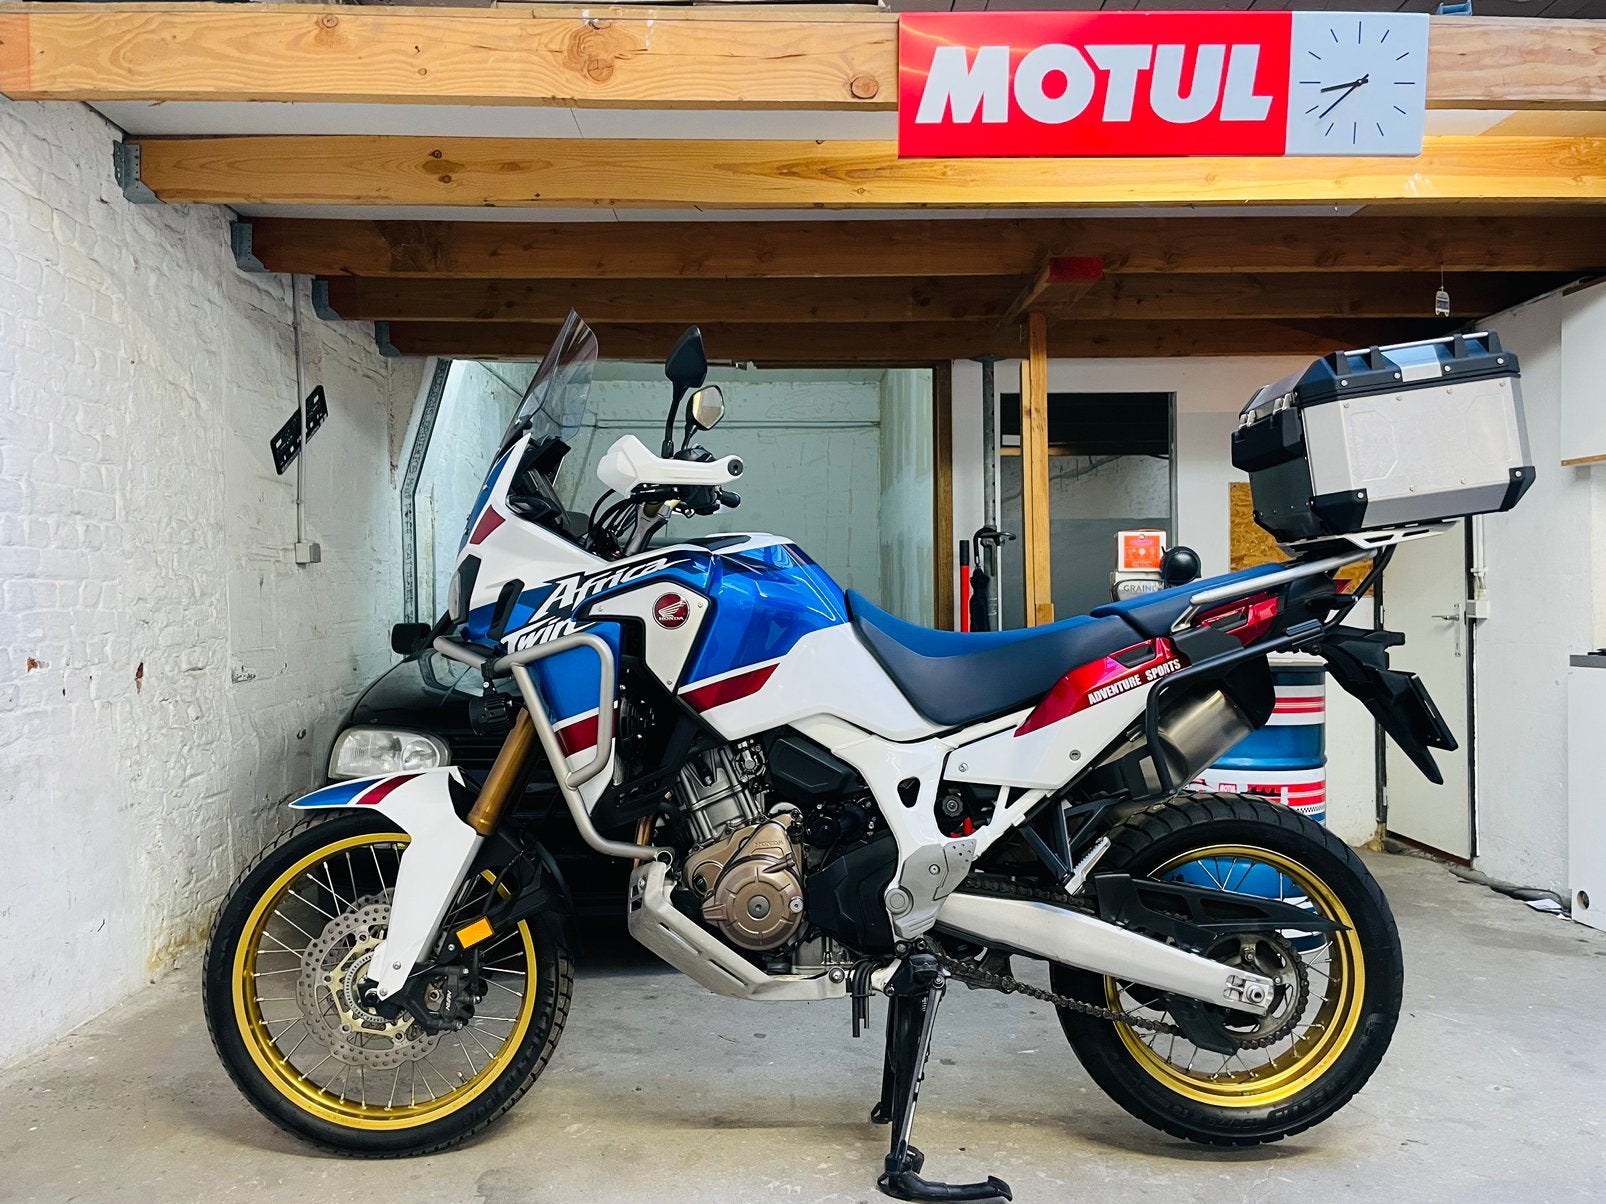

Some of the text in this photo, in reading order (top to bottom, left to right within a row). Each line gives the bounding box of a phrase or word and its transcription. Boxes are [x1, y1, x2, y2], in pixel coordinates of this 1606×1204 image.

[915, 43, 1273, 125] MOTUL
[528, 558, 691, 623] Africa
[500, 616, 597, 656] Twin
[1087, 658, 1181, 705] ADVENTURE SPORTS
